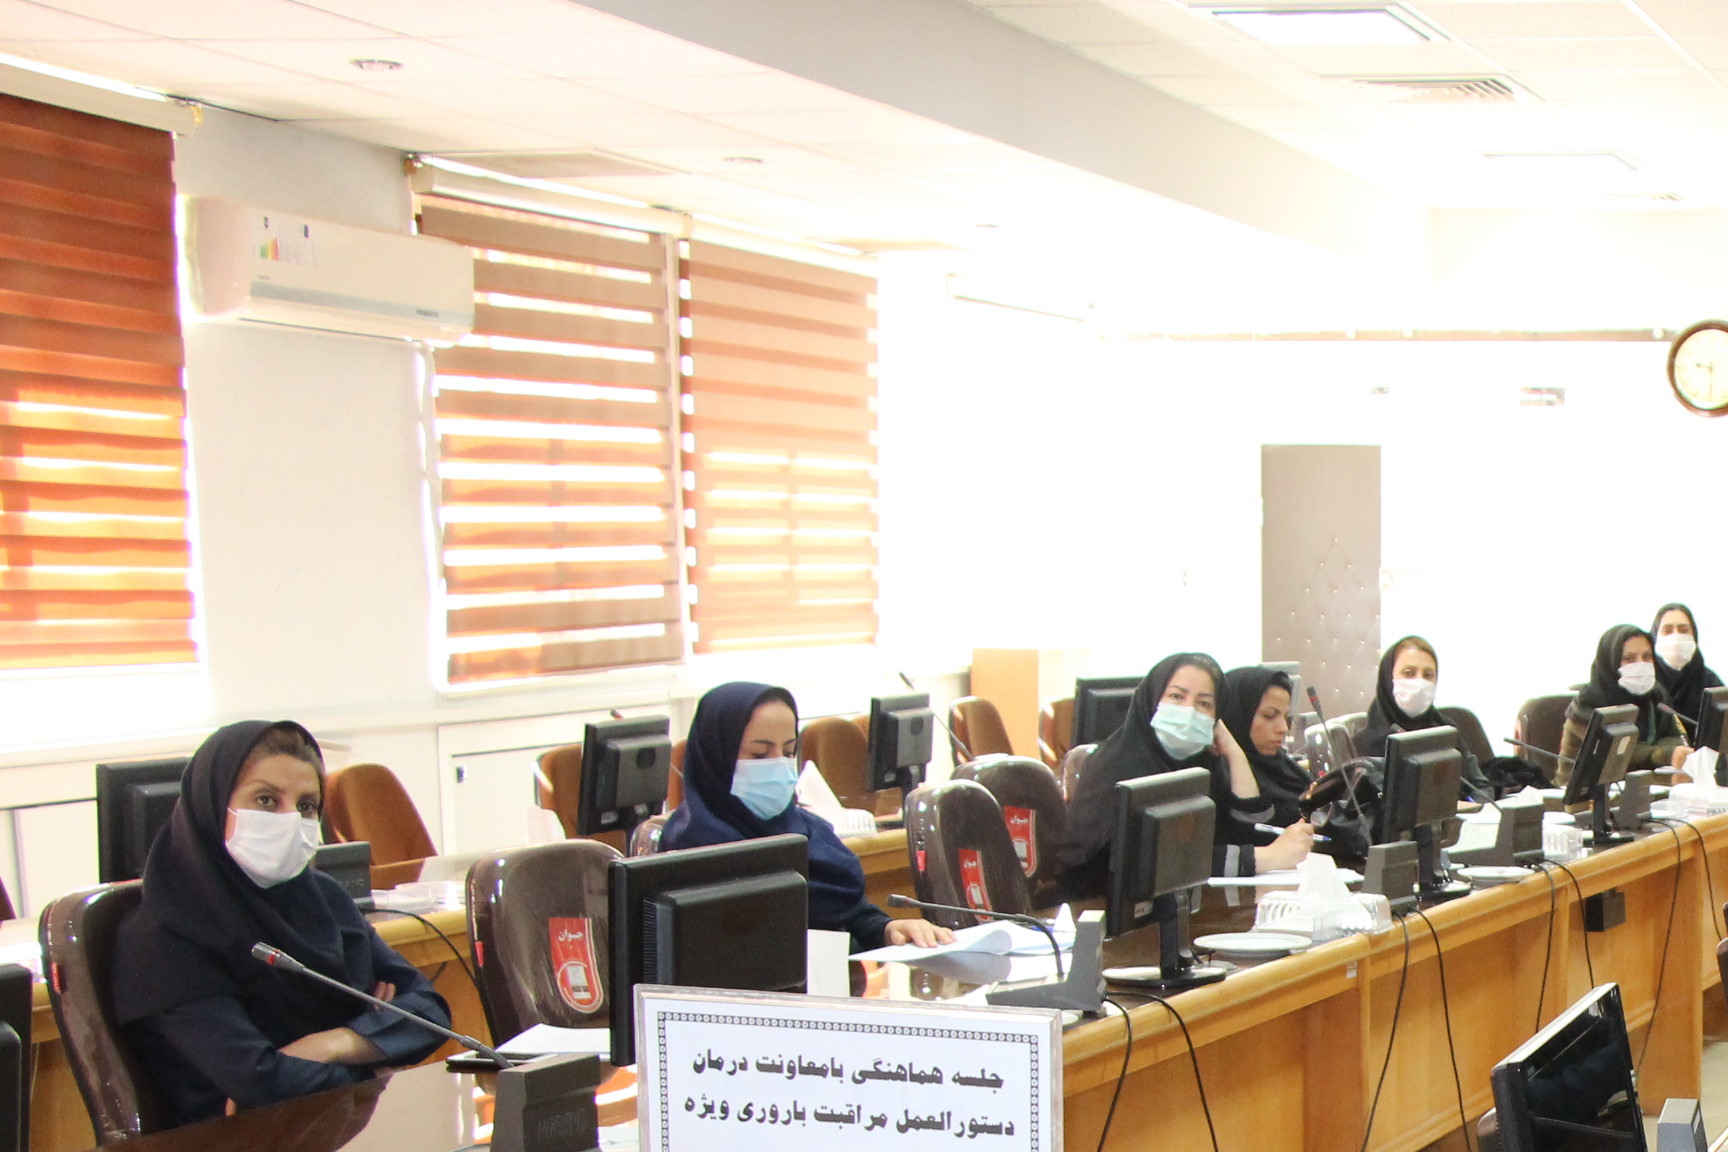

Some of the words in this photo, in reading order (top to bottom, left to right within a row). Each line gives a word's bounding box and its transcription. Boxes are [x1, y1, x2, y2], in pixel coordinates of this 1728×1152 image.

[692, 1048, 748, 1076] درمان
[851, 1057, 944, 1085] هماهنگی
[951, 1067, 1004, 1094] جلسه
[684, 1094, 730, 1121] ویژه
[736, 1100, 807, 1127] باروری
[813, 1103, 889, 1132] مراقبت
